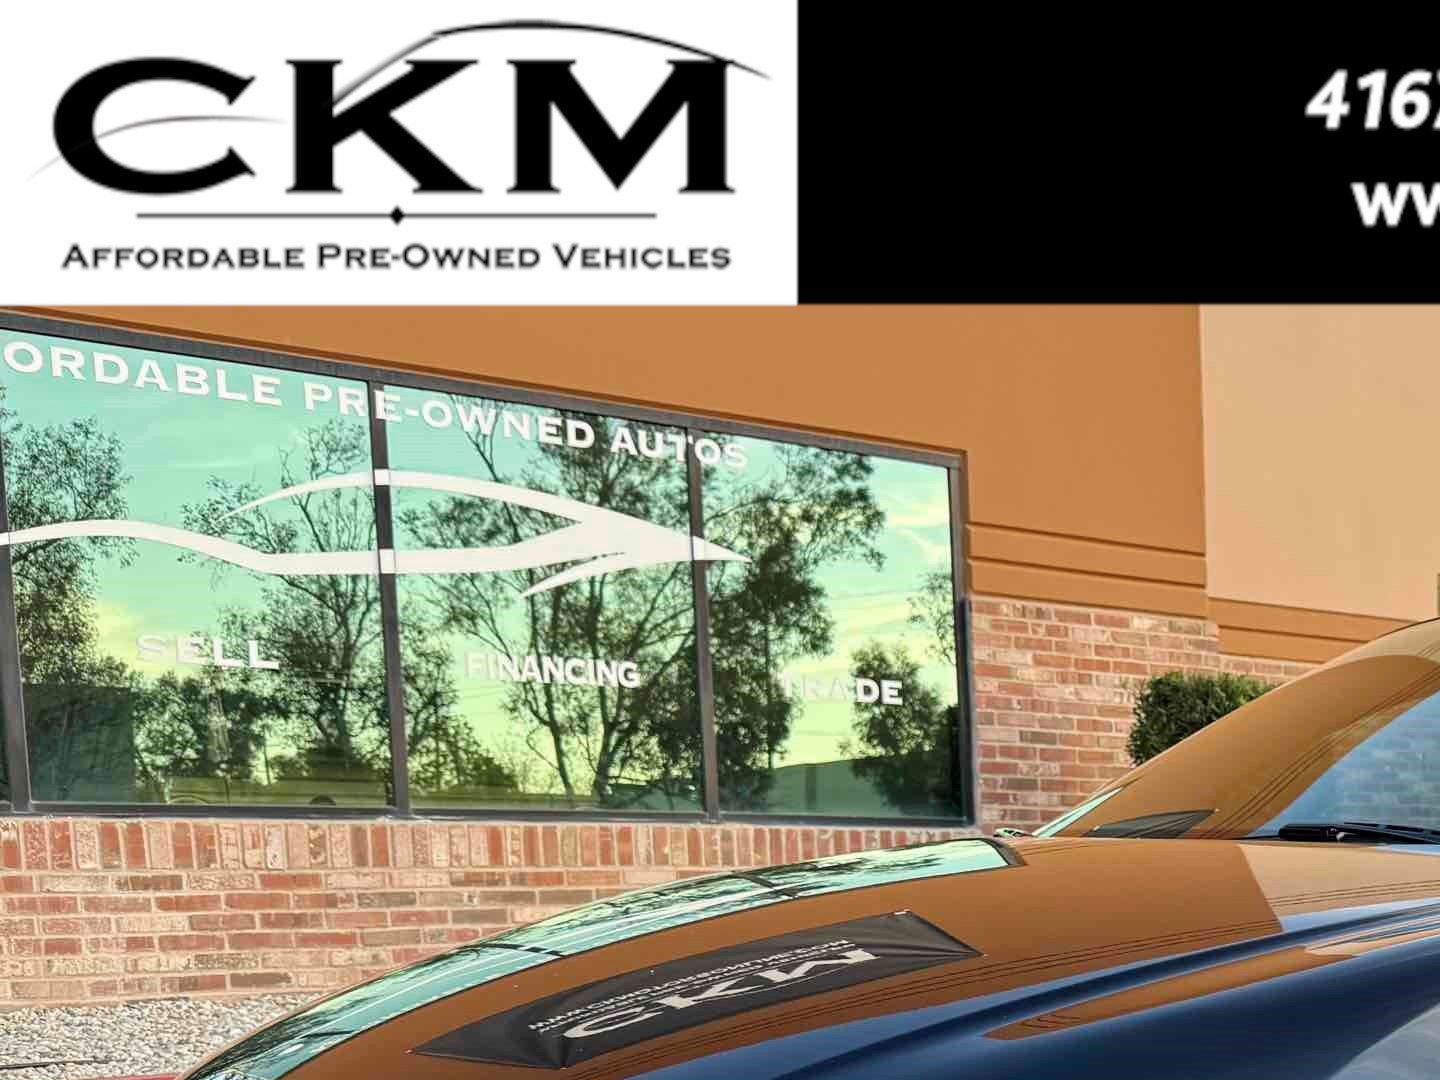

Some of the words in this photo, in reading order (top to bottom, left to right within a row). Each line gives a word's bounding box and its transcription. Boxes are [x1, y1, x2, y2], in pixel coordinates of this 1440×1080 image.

[3, 341, 283, 407] ORDABLE
[302, 382, 596, 449] PRE-OWNED
[609, 426, 748, 469] AUTOS
[136, 634, 280, 669] SELL
[464, 652, 641, 689] FINANCING
[781, 671, 903, 706] TRADE
